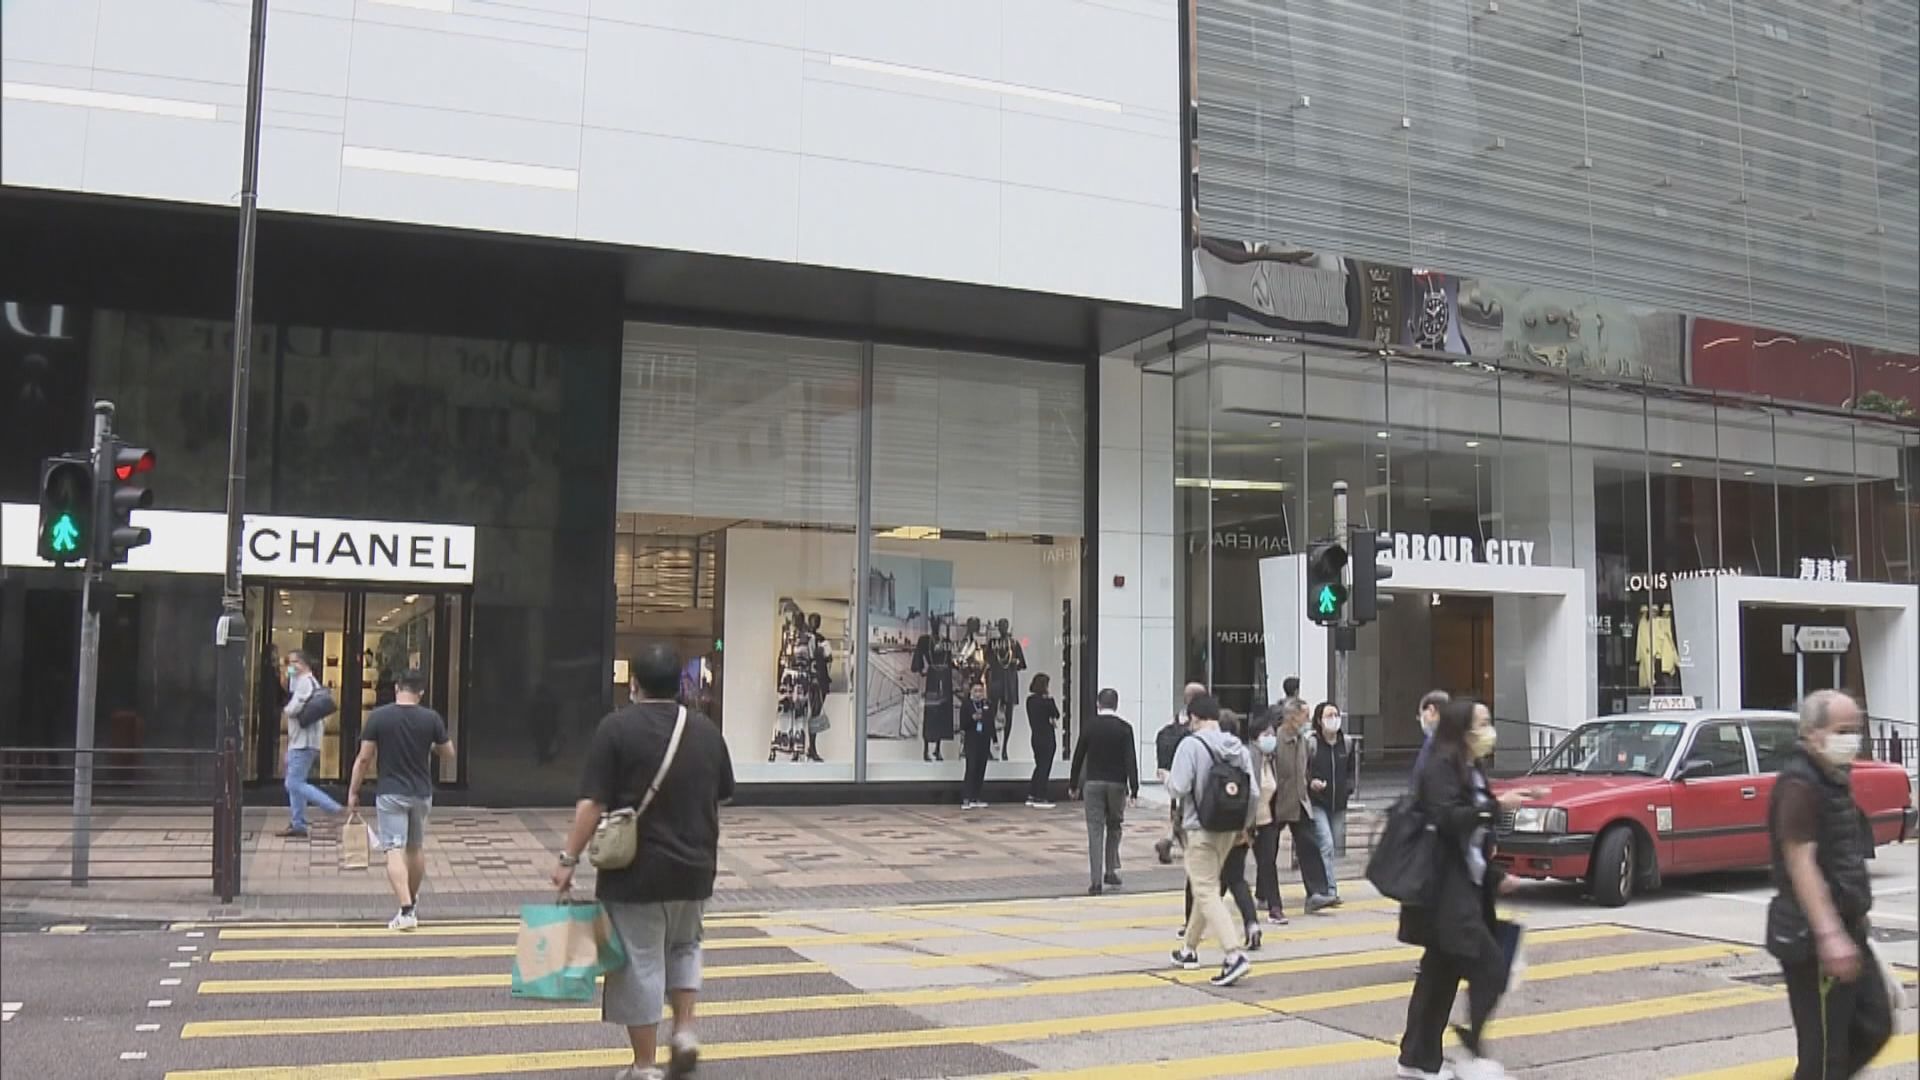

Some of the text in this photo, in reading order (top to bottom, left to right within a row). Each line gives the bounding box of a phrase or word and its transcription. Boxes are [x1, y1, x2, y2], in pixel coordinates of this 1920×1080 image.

[249, 528, 467, 570] CHANEL
[1485, 538, 1535, 566] CITY
[1625, 572, 1667, 591] LOUIS
[1800, 557, 1847, 582] 海港城
[1652, 699, 1686, 709] TAXI
